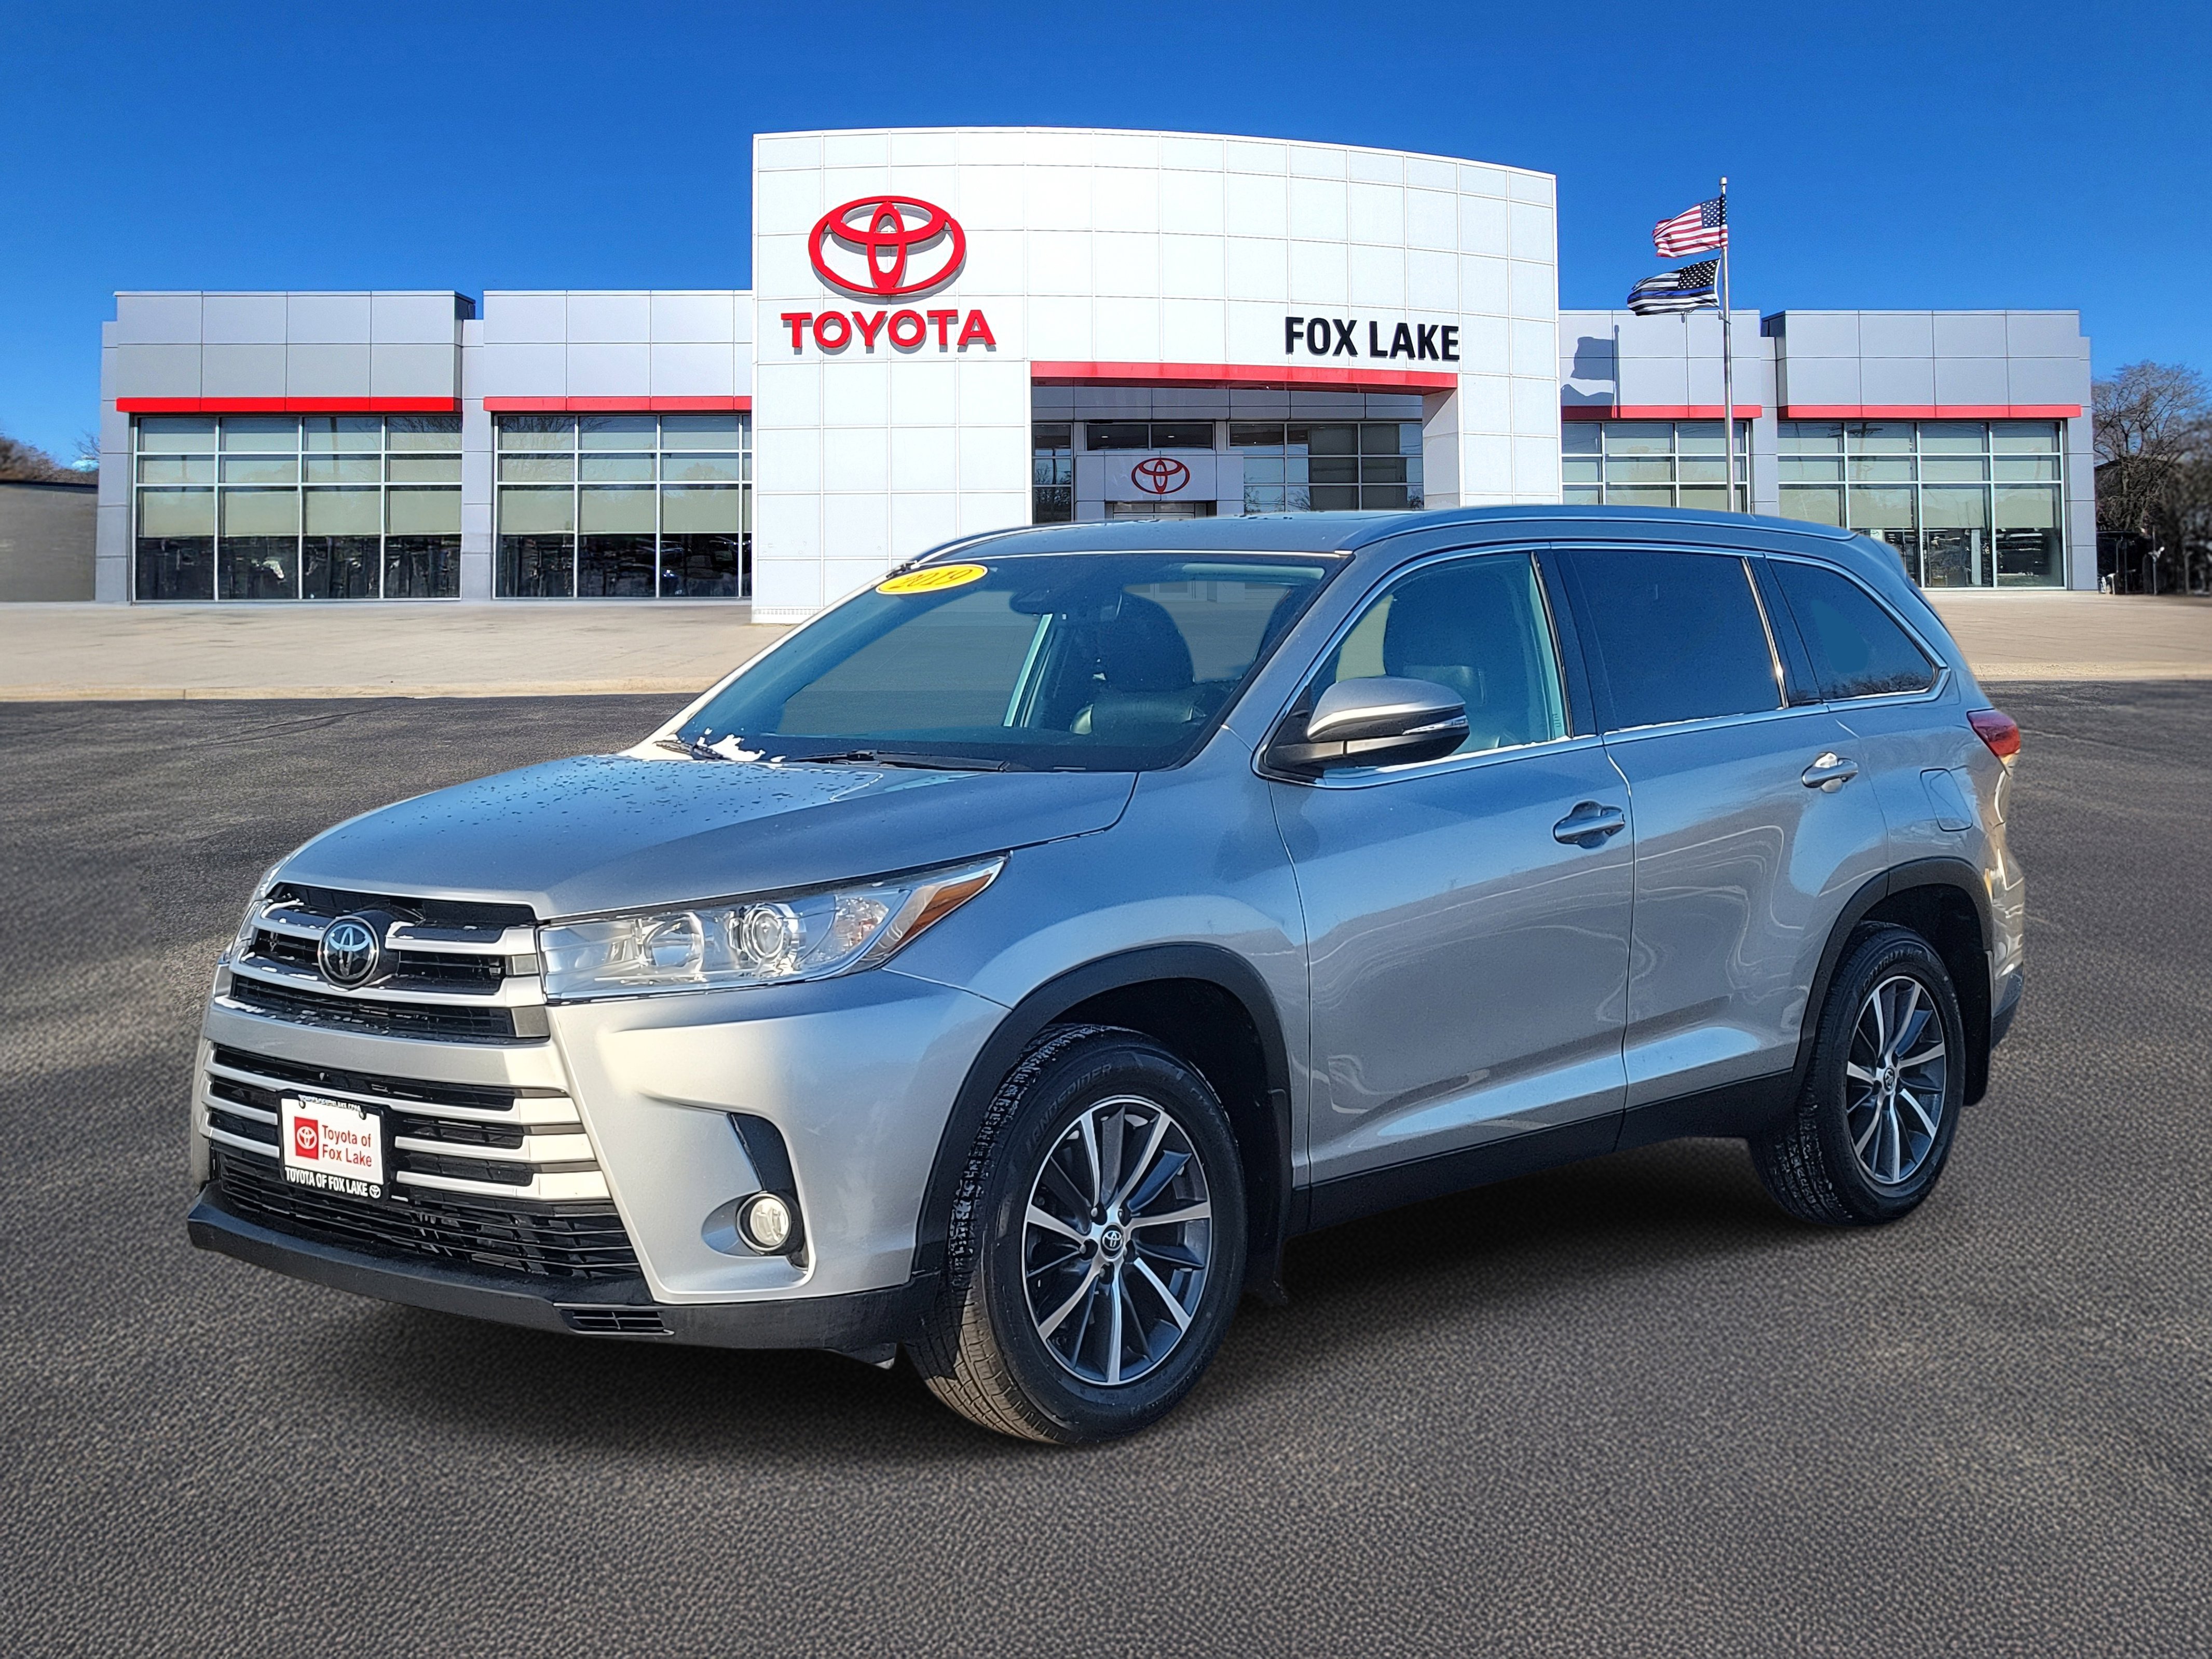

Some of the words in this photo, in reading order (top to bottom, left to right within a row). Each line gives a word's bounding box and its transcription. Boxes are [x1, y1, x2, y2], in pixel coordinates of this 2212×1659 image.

[781, 309, 996, 348] TOYOTA
[1285, 316, 1358, 357] FOX
[1369, 320, 1460, 361] LAKE
[888, 569, 973, 590] 2019
[322, 1124, 358, 1145] Toyota
[361, 1133, 371, 1148] of
[322, 1144, 342, 1161] Fox
[346, 1148, 372, 1167] Lake
[285, 1166, 316, 1187] TOYOTA
[316, 1172, 327, 1189] OF
[328, 1175, 346, 1193] FOX
[346, 1179, 368, 1197] LAKE
